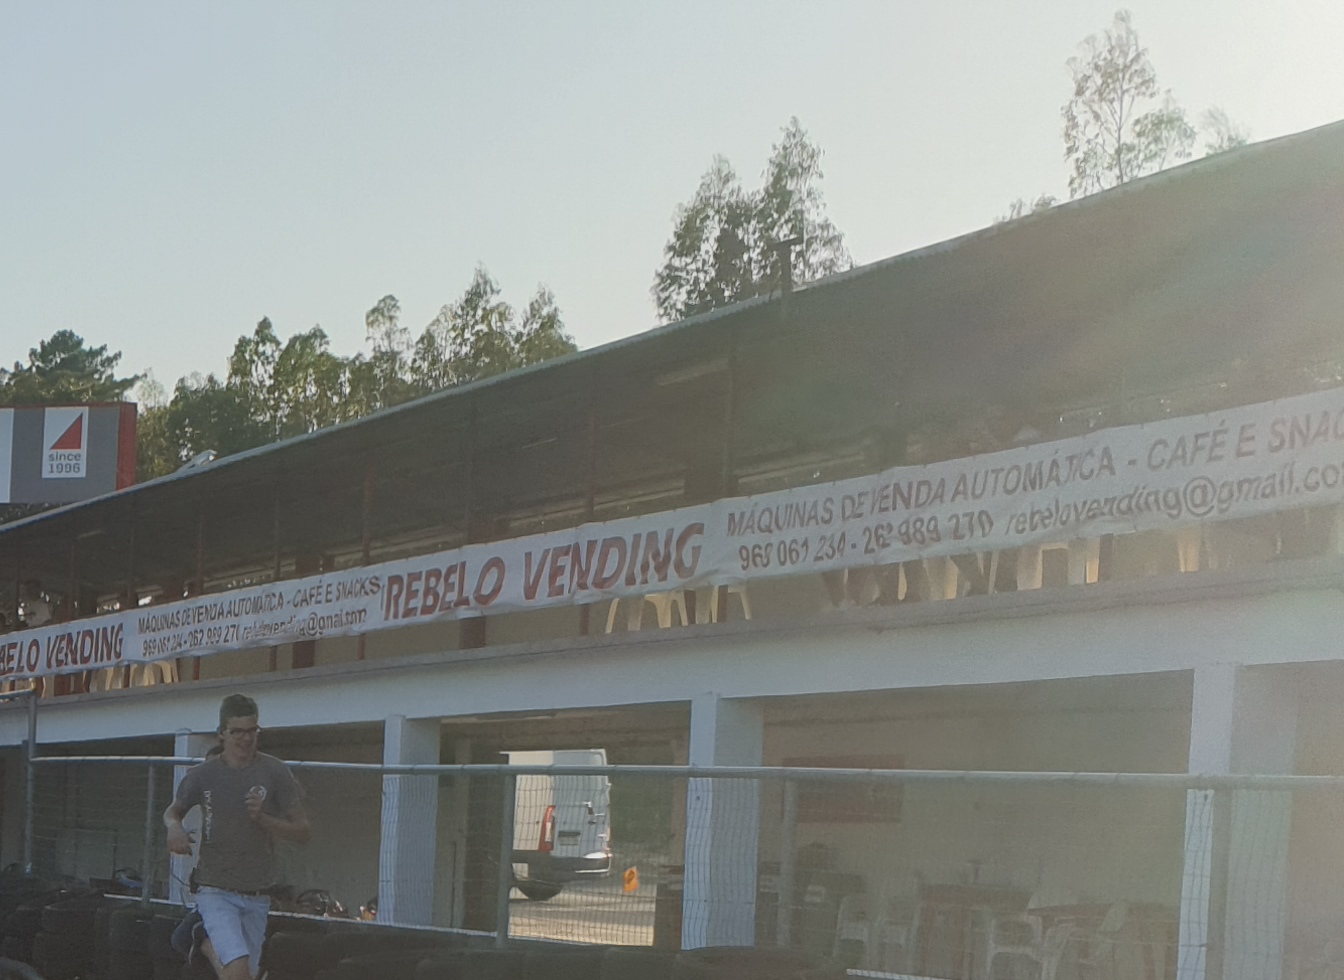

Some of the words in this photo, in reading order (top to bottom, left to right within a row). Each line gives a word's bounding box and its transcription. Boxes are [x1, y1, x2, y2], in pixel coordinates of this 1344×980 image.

[46, 462, 82, 475] 1996
[47, 450, 83, 462] since
[727, 501, 834, 538] MÁQUINAS
[1146, 418, 1229, 471] CAFÉ
[1235, 423, 1257, 458] E
[1002, 460, 1344, 536] rebelovending@gmail.co
[292, 579, 323, 608] CAFÉ
[335, 575, 382, 600] SNACKS
[382, 556, 507, 621] REBELO
[523, 522, 705, 602] VENDING
[46, 622, 124, 669] VENDING
